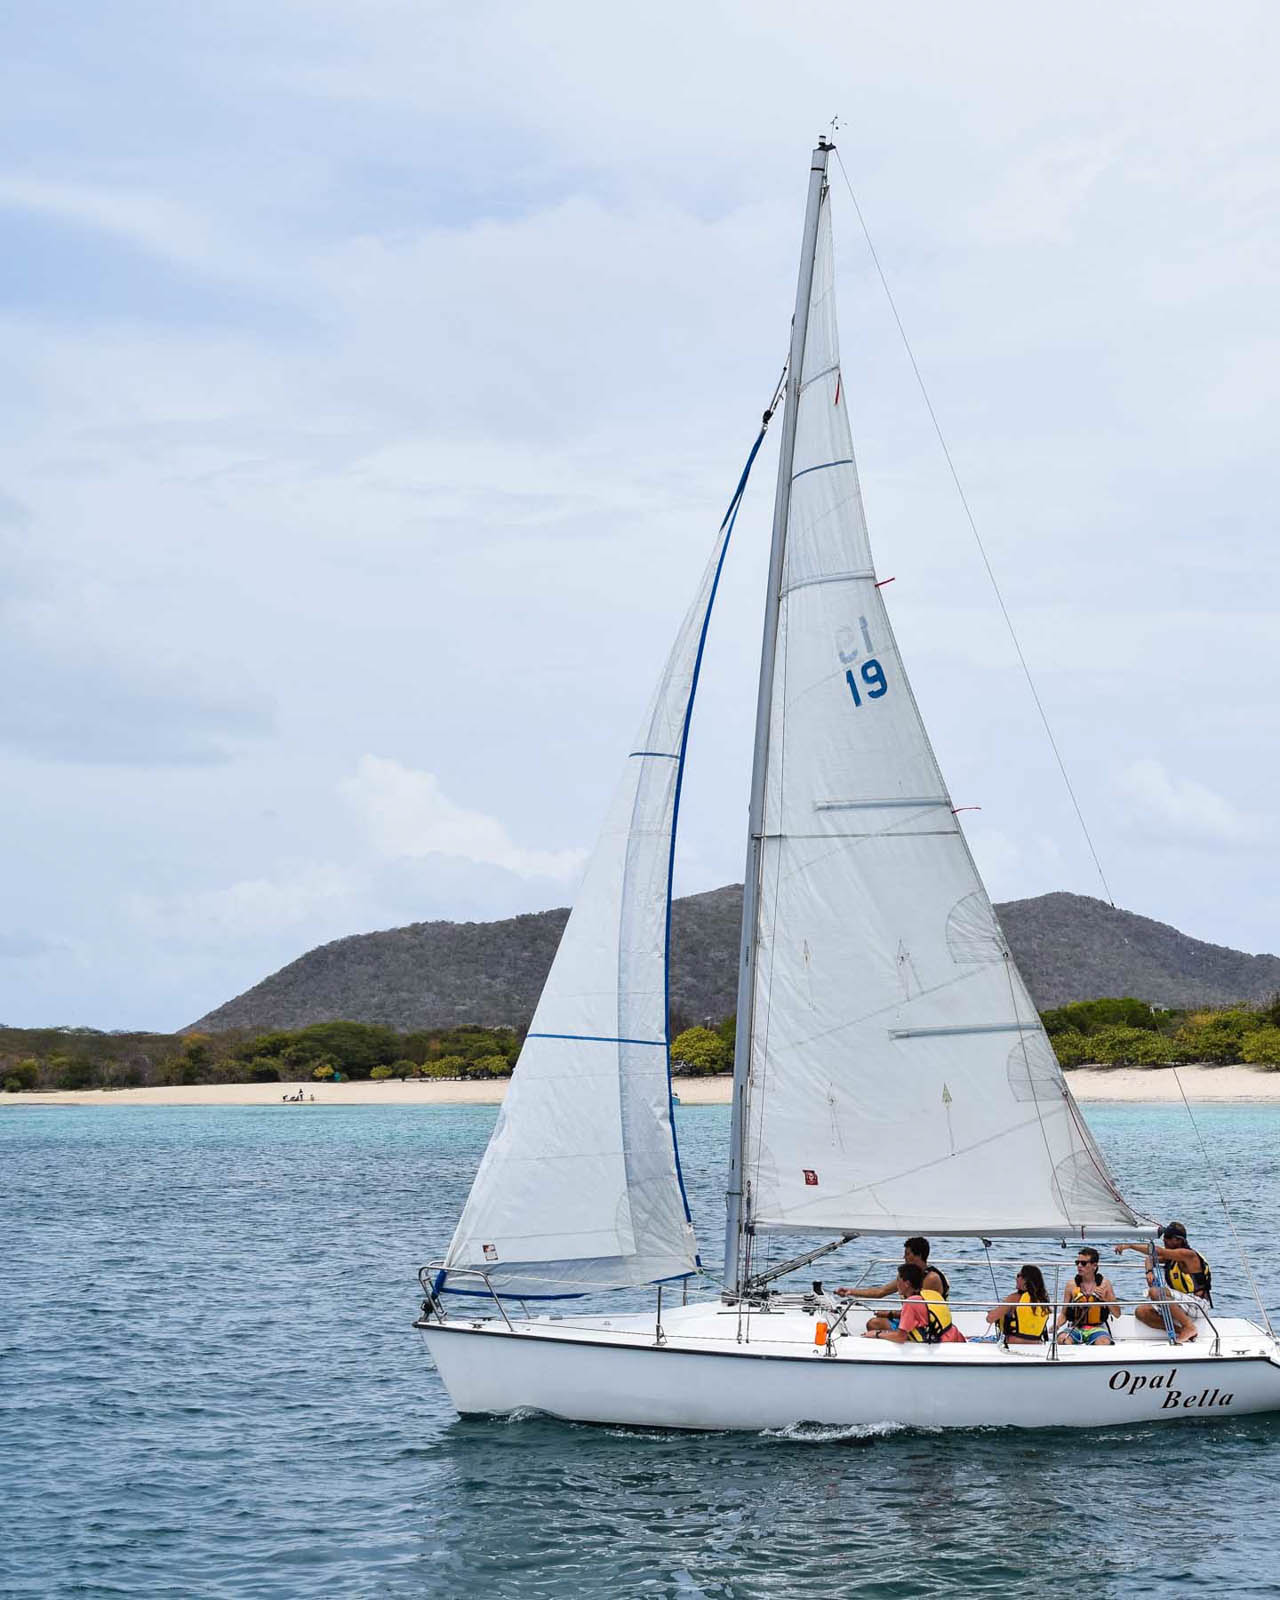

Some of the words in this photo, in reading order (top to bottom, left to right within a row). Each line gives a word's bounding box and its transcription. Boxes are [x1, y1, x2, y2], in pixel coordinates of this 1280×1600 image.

[846, 659, 888, 707] 19
[1109, 1368, 1177, 1395] Opal
[1161, 1389, 1234, 1409] Bella
